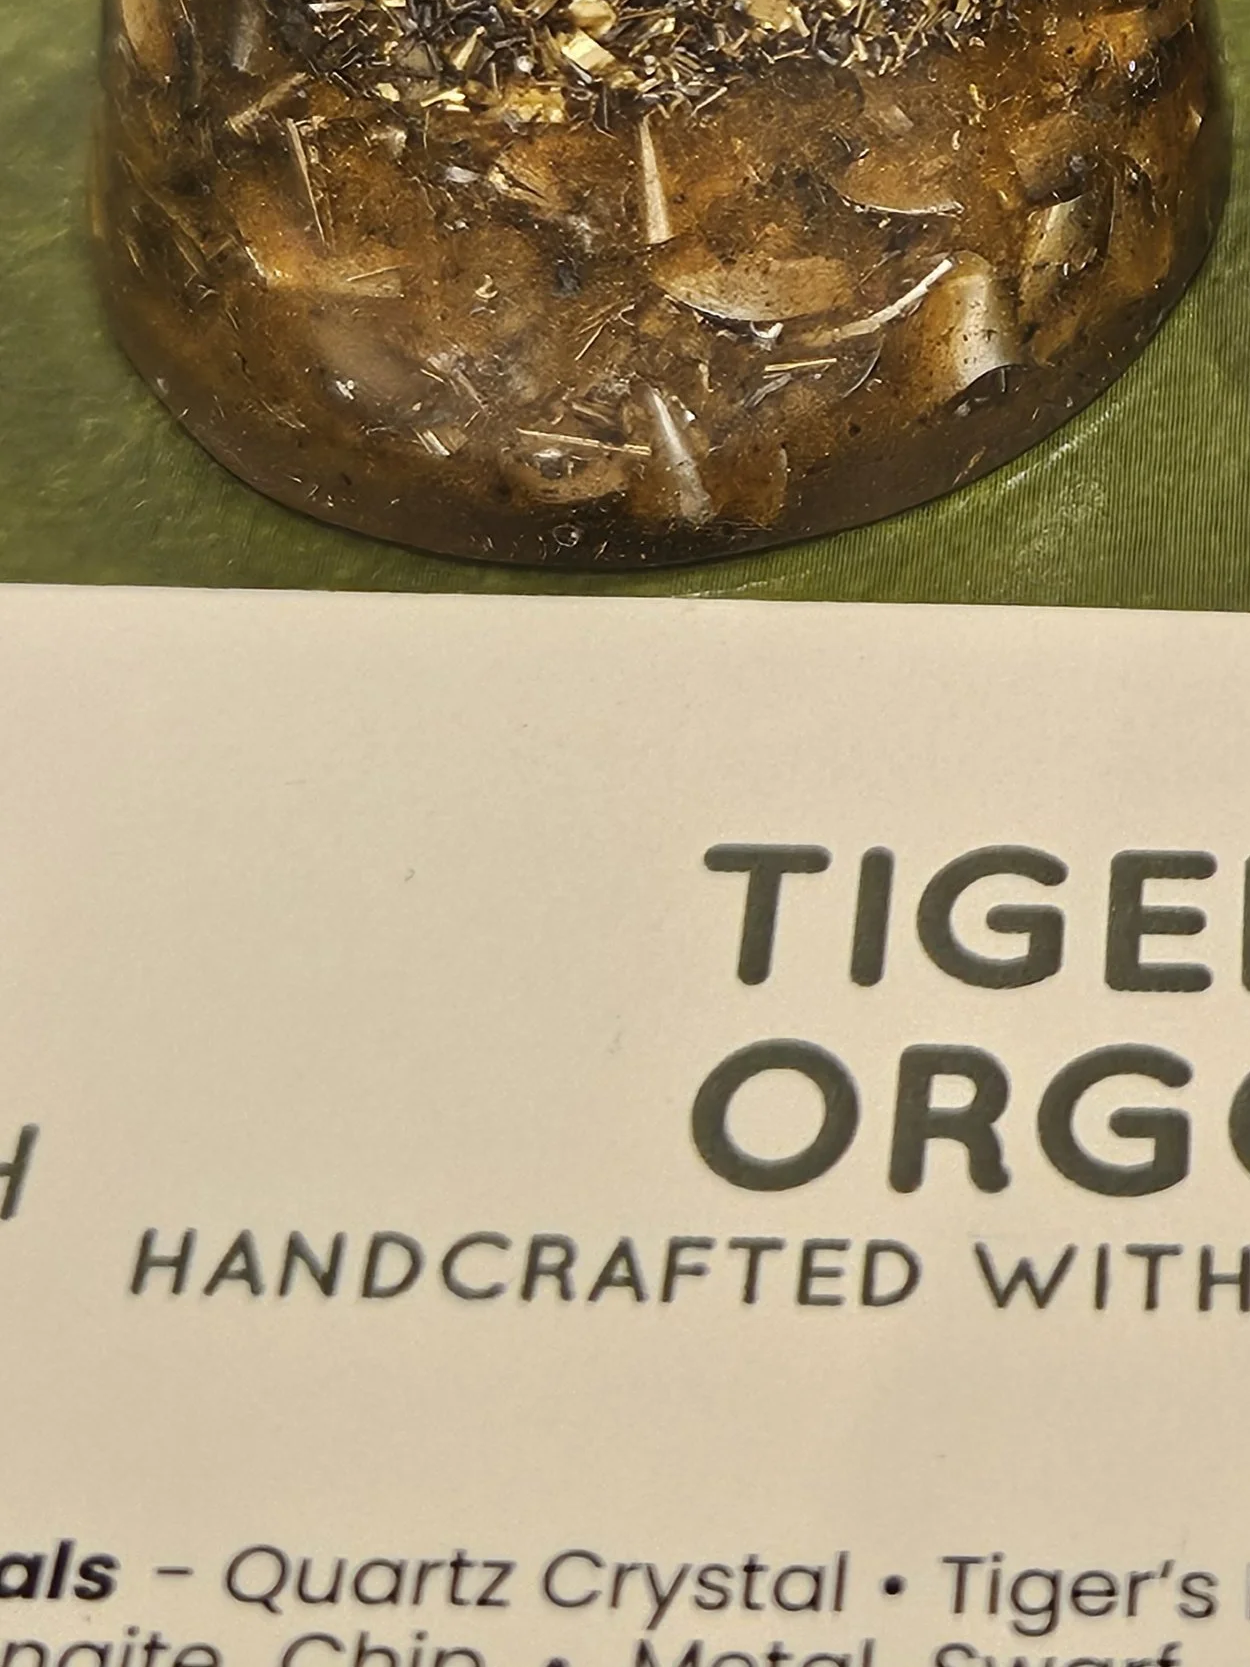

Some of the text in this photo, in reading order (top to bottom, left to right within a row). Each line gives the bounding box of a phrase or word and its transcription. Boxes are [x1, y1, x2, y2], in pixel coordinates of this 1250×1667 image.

[127, 1226, 923, 1309] HANDCRAFTED
[222, 1543, 518, 1617] Quartz
[540, 1548, 850, 1633] Crystal
[940, 1551, 1219, 1639] Tiger’s
